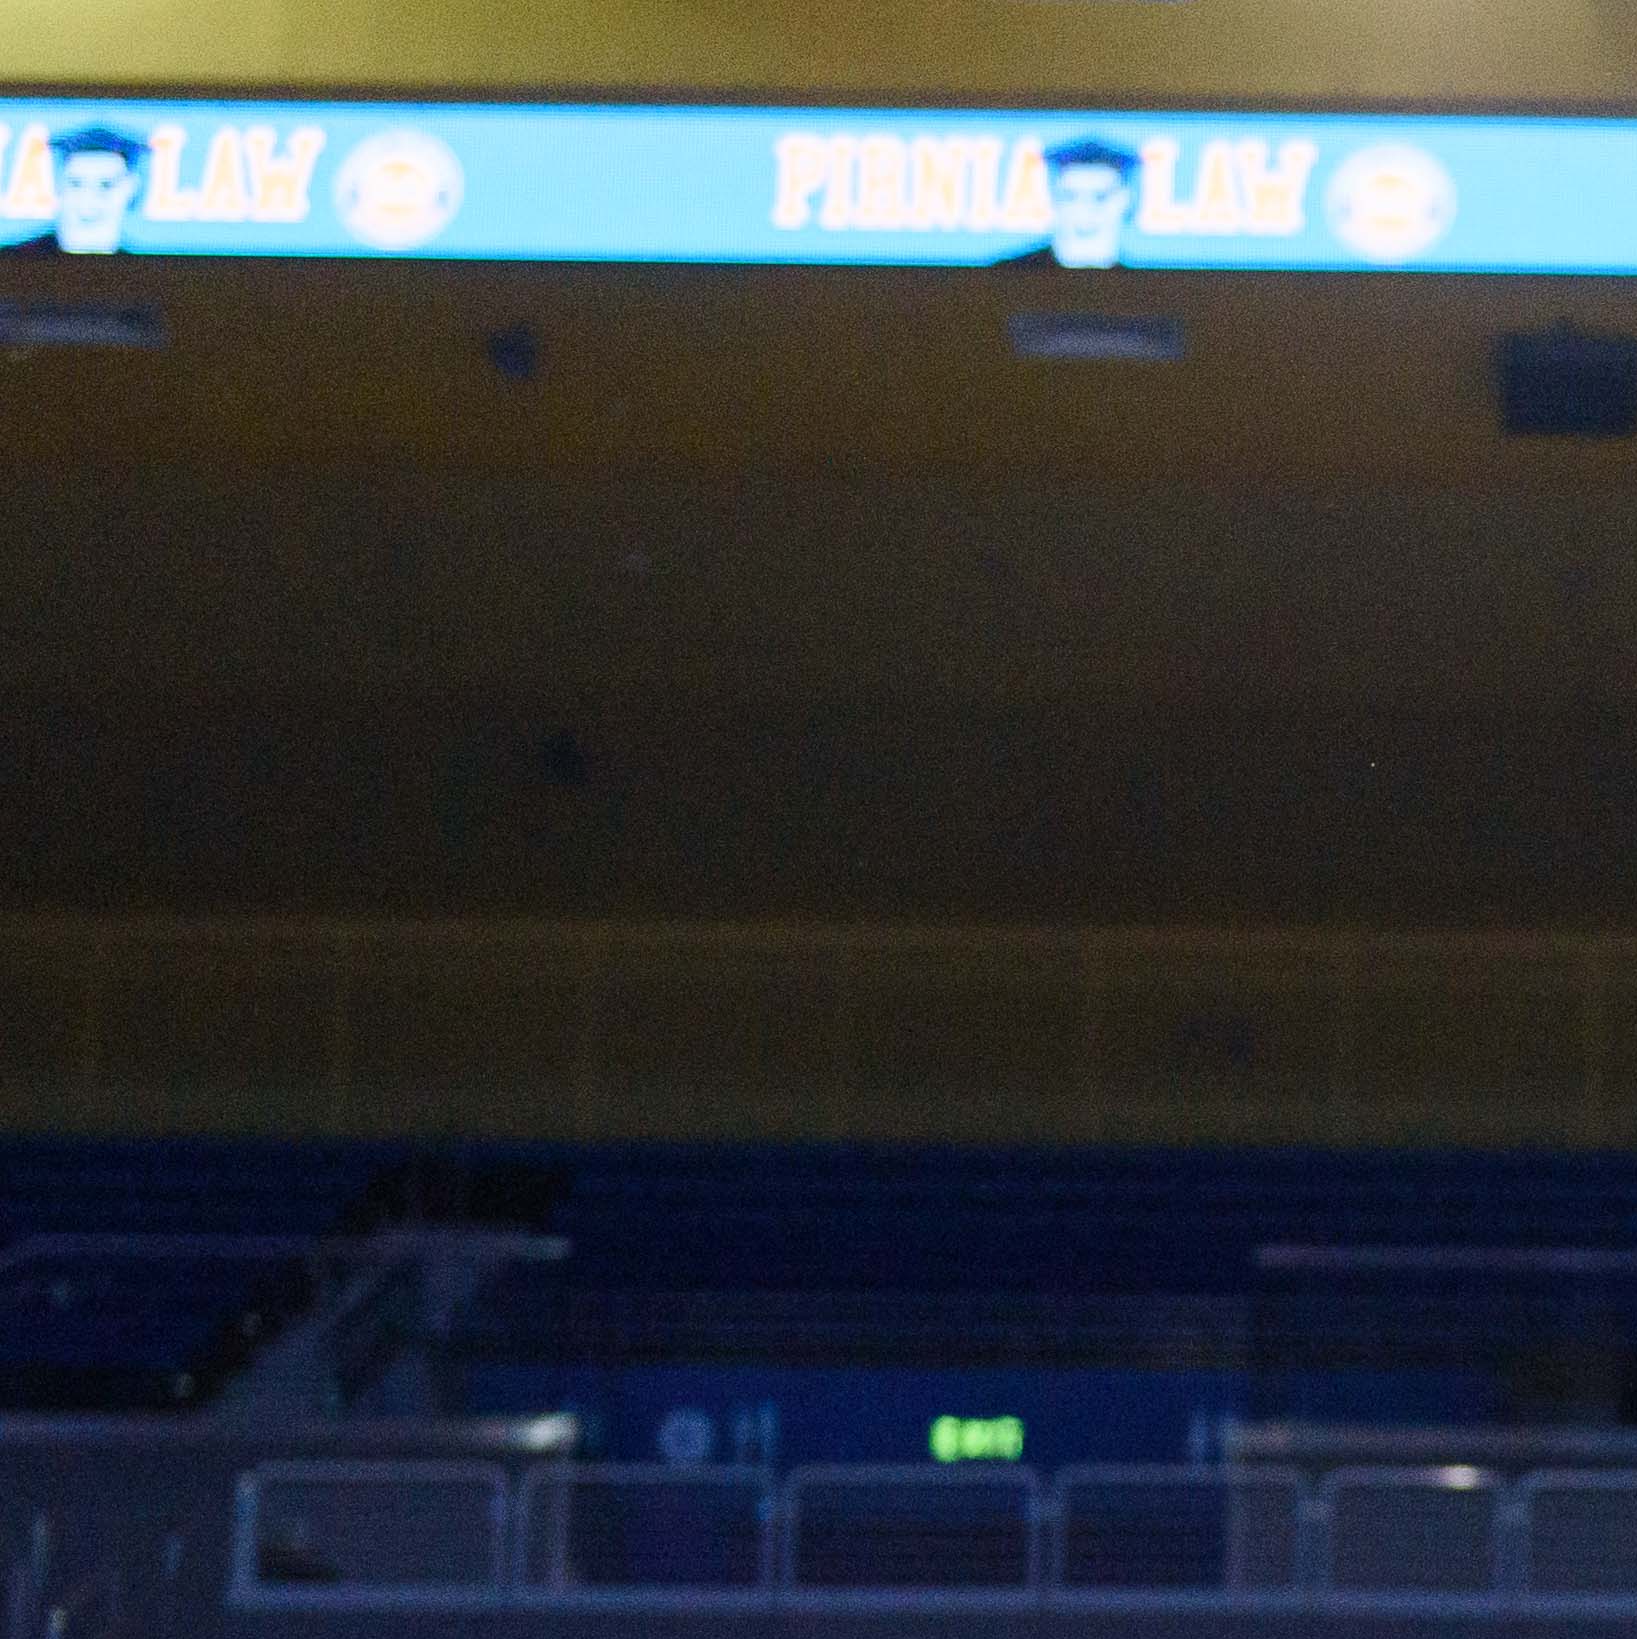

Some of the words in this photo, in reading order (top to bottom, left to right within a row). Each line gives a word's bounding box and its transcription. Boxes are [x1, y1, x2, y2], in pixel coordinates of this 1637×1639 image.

[144, 124, 327, 222] LAW
[772, 134, 1055, 232] PIRNIA
[1138, 138, 1319, 235] LAW
